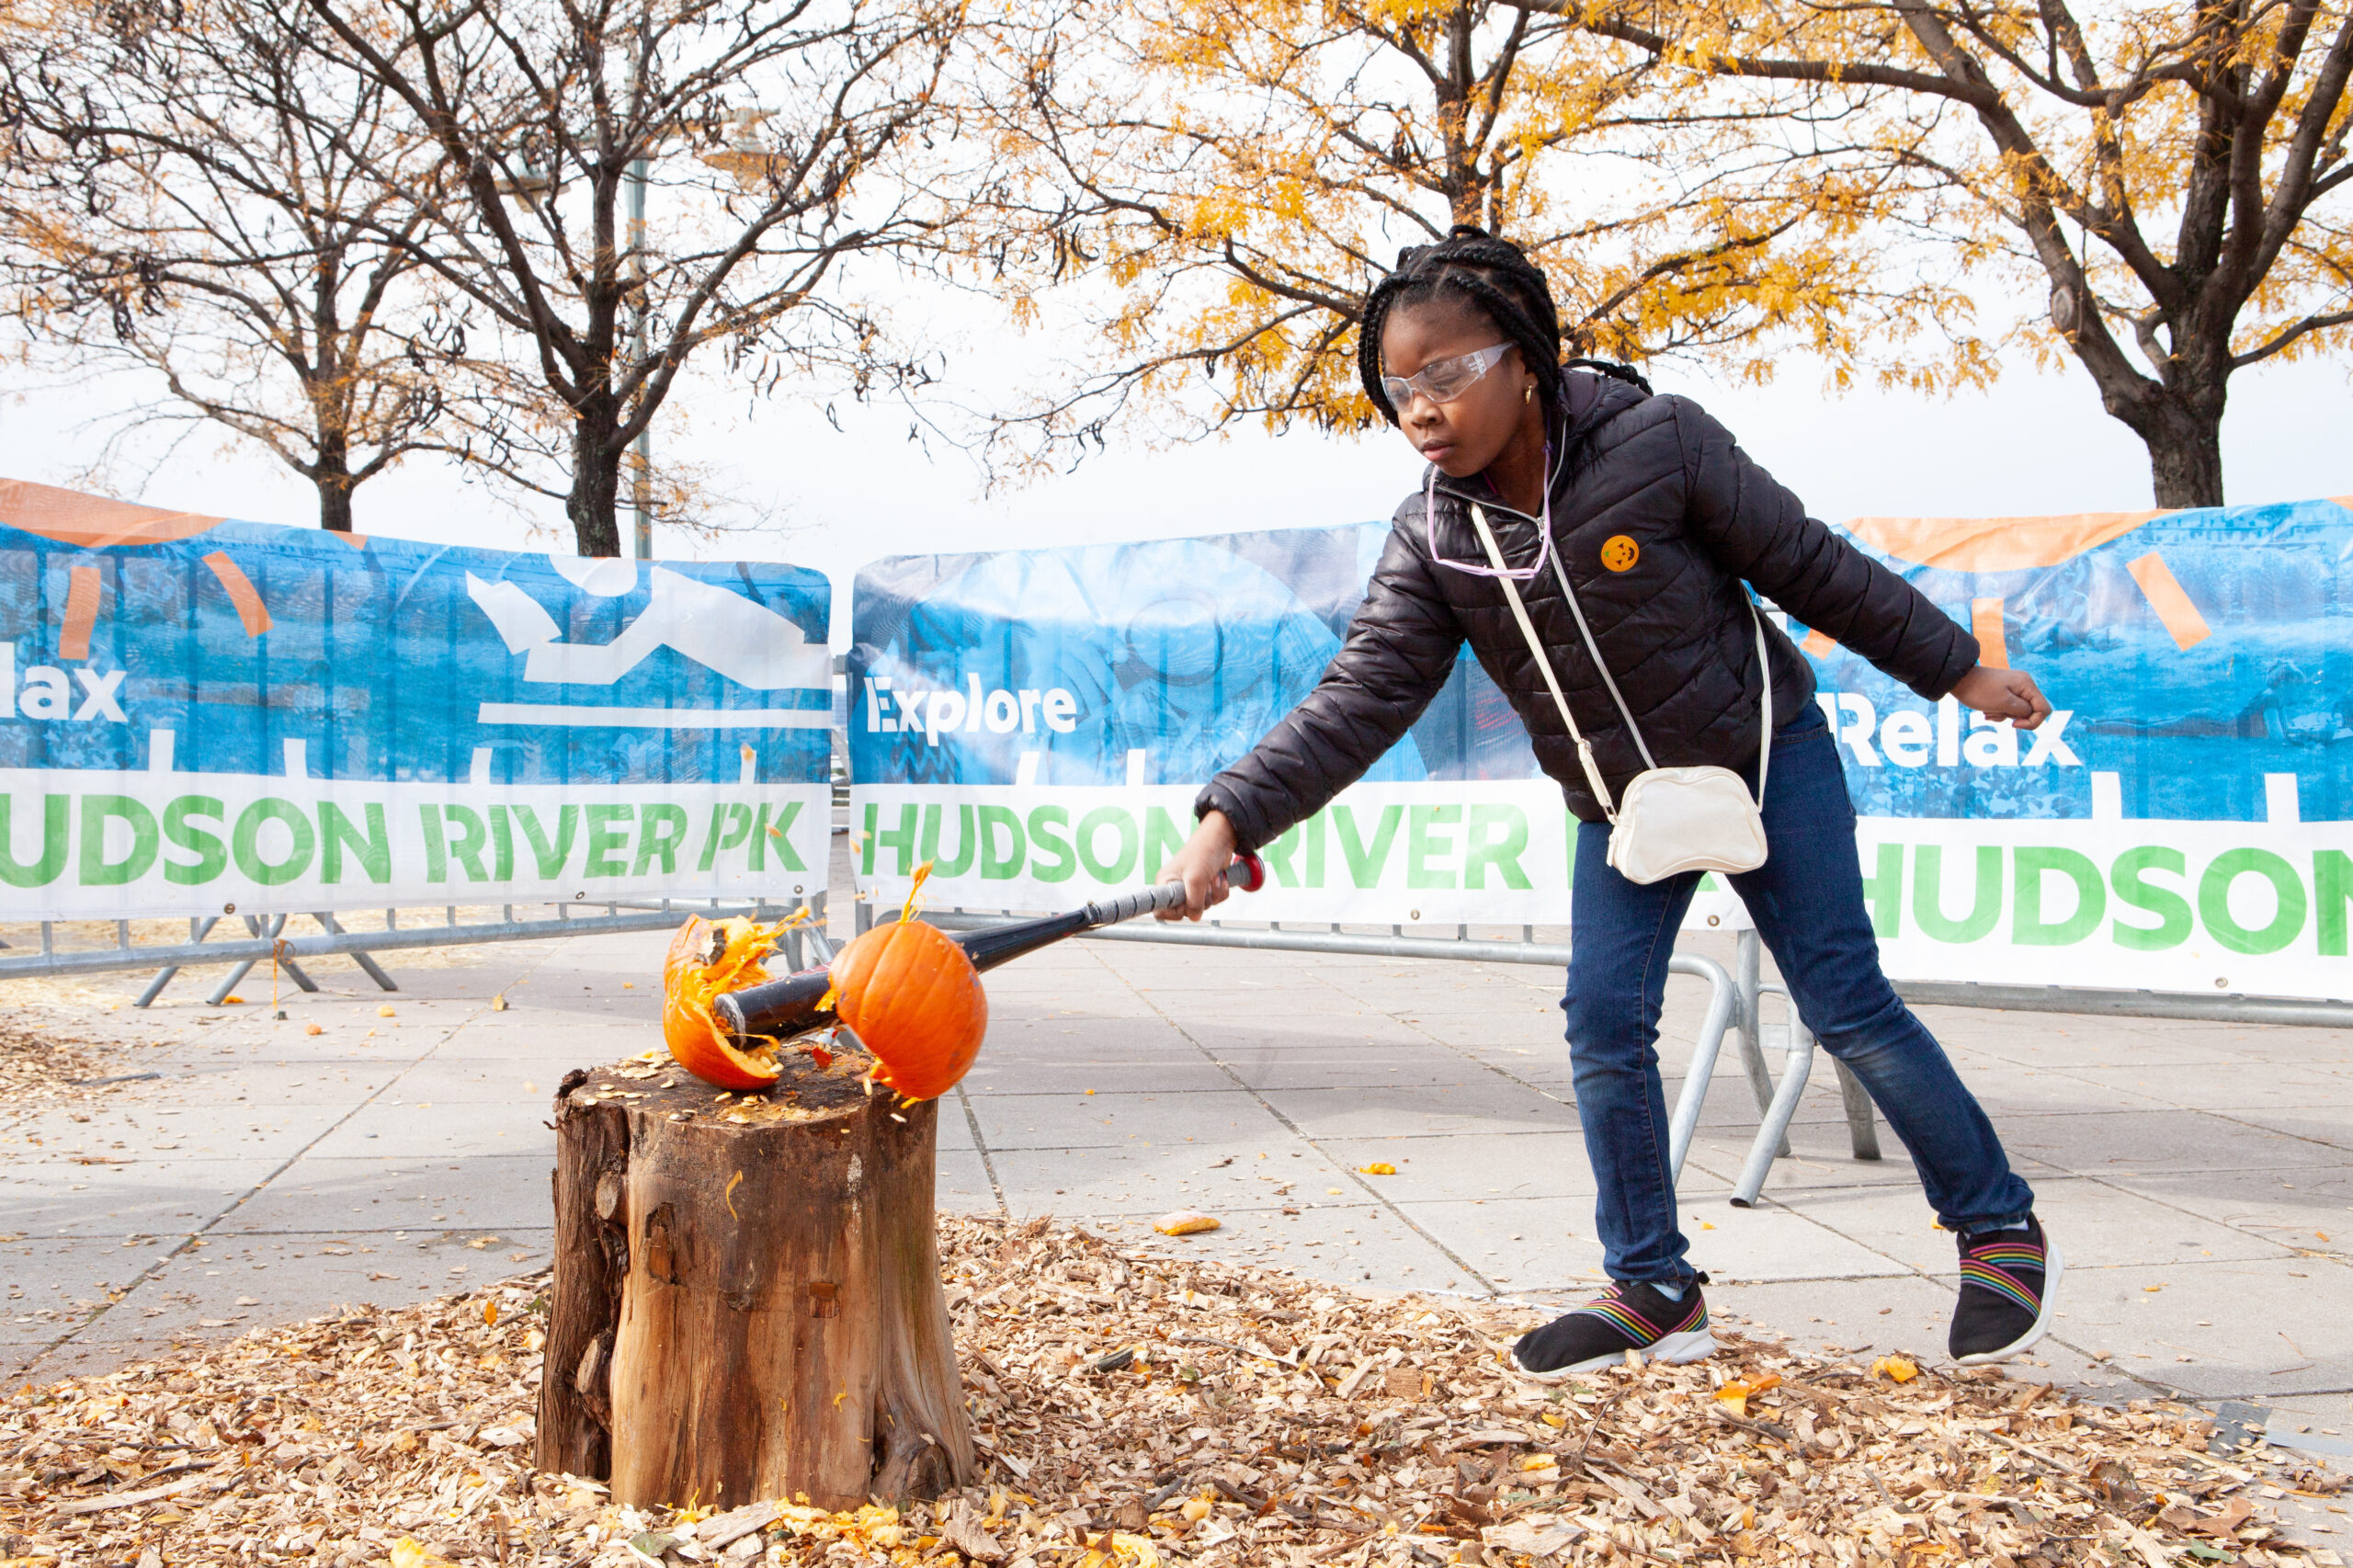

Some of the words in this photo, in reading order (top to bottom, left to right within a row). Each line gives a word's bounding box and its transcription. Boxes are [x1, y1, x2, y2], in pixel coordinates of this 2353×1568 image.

[864, 672, 1076, 746] Explore
[1814, 692, 2083, 767] Relax
[419, 802, 688, 883] RIVER
[697, 801, 808, 872] PK
